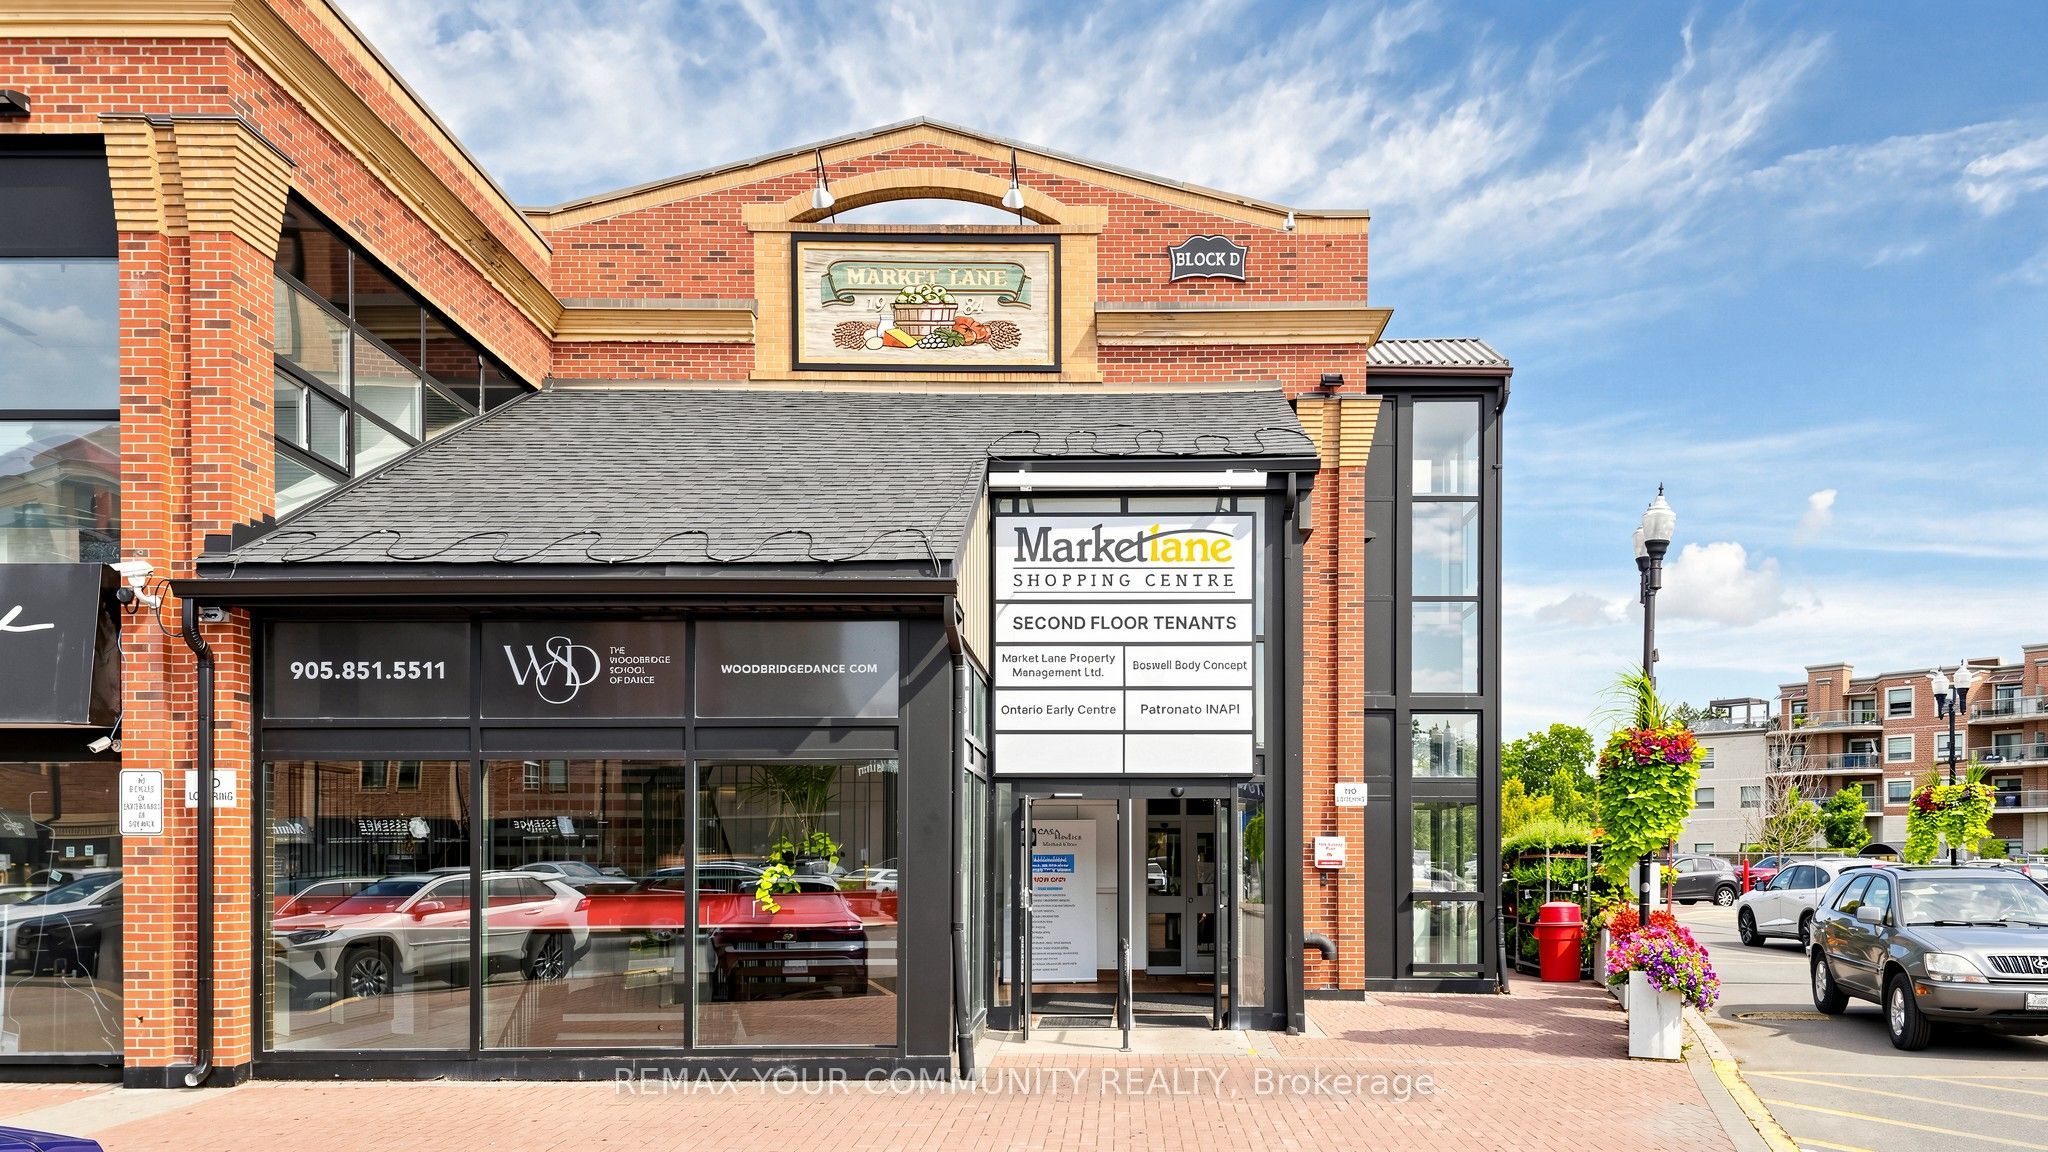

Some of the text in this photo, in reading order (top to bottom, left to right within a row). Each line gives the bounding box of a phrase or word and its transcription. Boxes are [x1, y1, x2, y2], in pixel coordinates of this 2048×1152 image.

[1175, 252, 1241, 266] BLOCK D
[847, 267, 1008, 286] MARKET LANE
[866, 297, 984, 315] 19 84
[1013, 573, 1235, 588] SHOPPING CENTRE
[1012, 616, 1237, 630] SECOND FLOOR TENANTS
[610, 647, 625, 655] THE
[610, 656, 671, 664] WOODBRIDGE
[1001, 654, 1116, 665] Market Lane Property
[290, 661, 445, 680] 905.851.5511
[610, 666, 645, 674] SCHOOL
[1133, 660, 1248, 673] Boswell Body Concept
[1012, 668, 1104, 679] Management Ltd.
[610, 676, 655, 684] OF DANCE
[1001, 705, 1117, 717] Ontario Early Centre
[1140, 704, 1240, 715] Patronato INAPI
[188, 791, 233, 801] LORING
